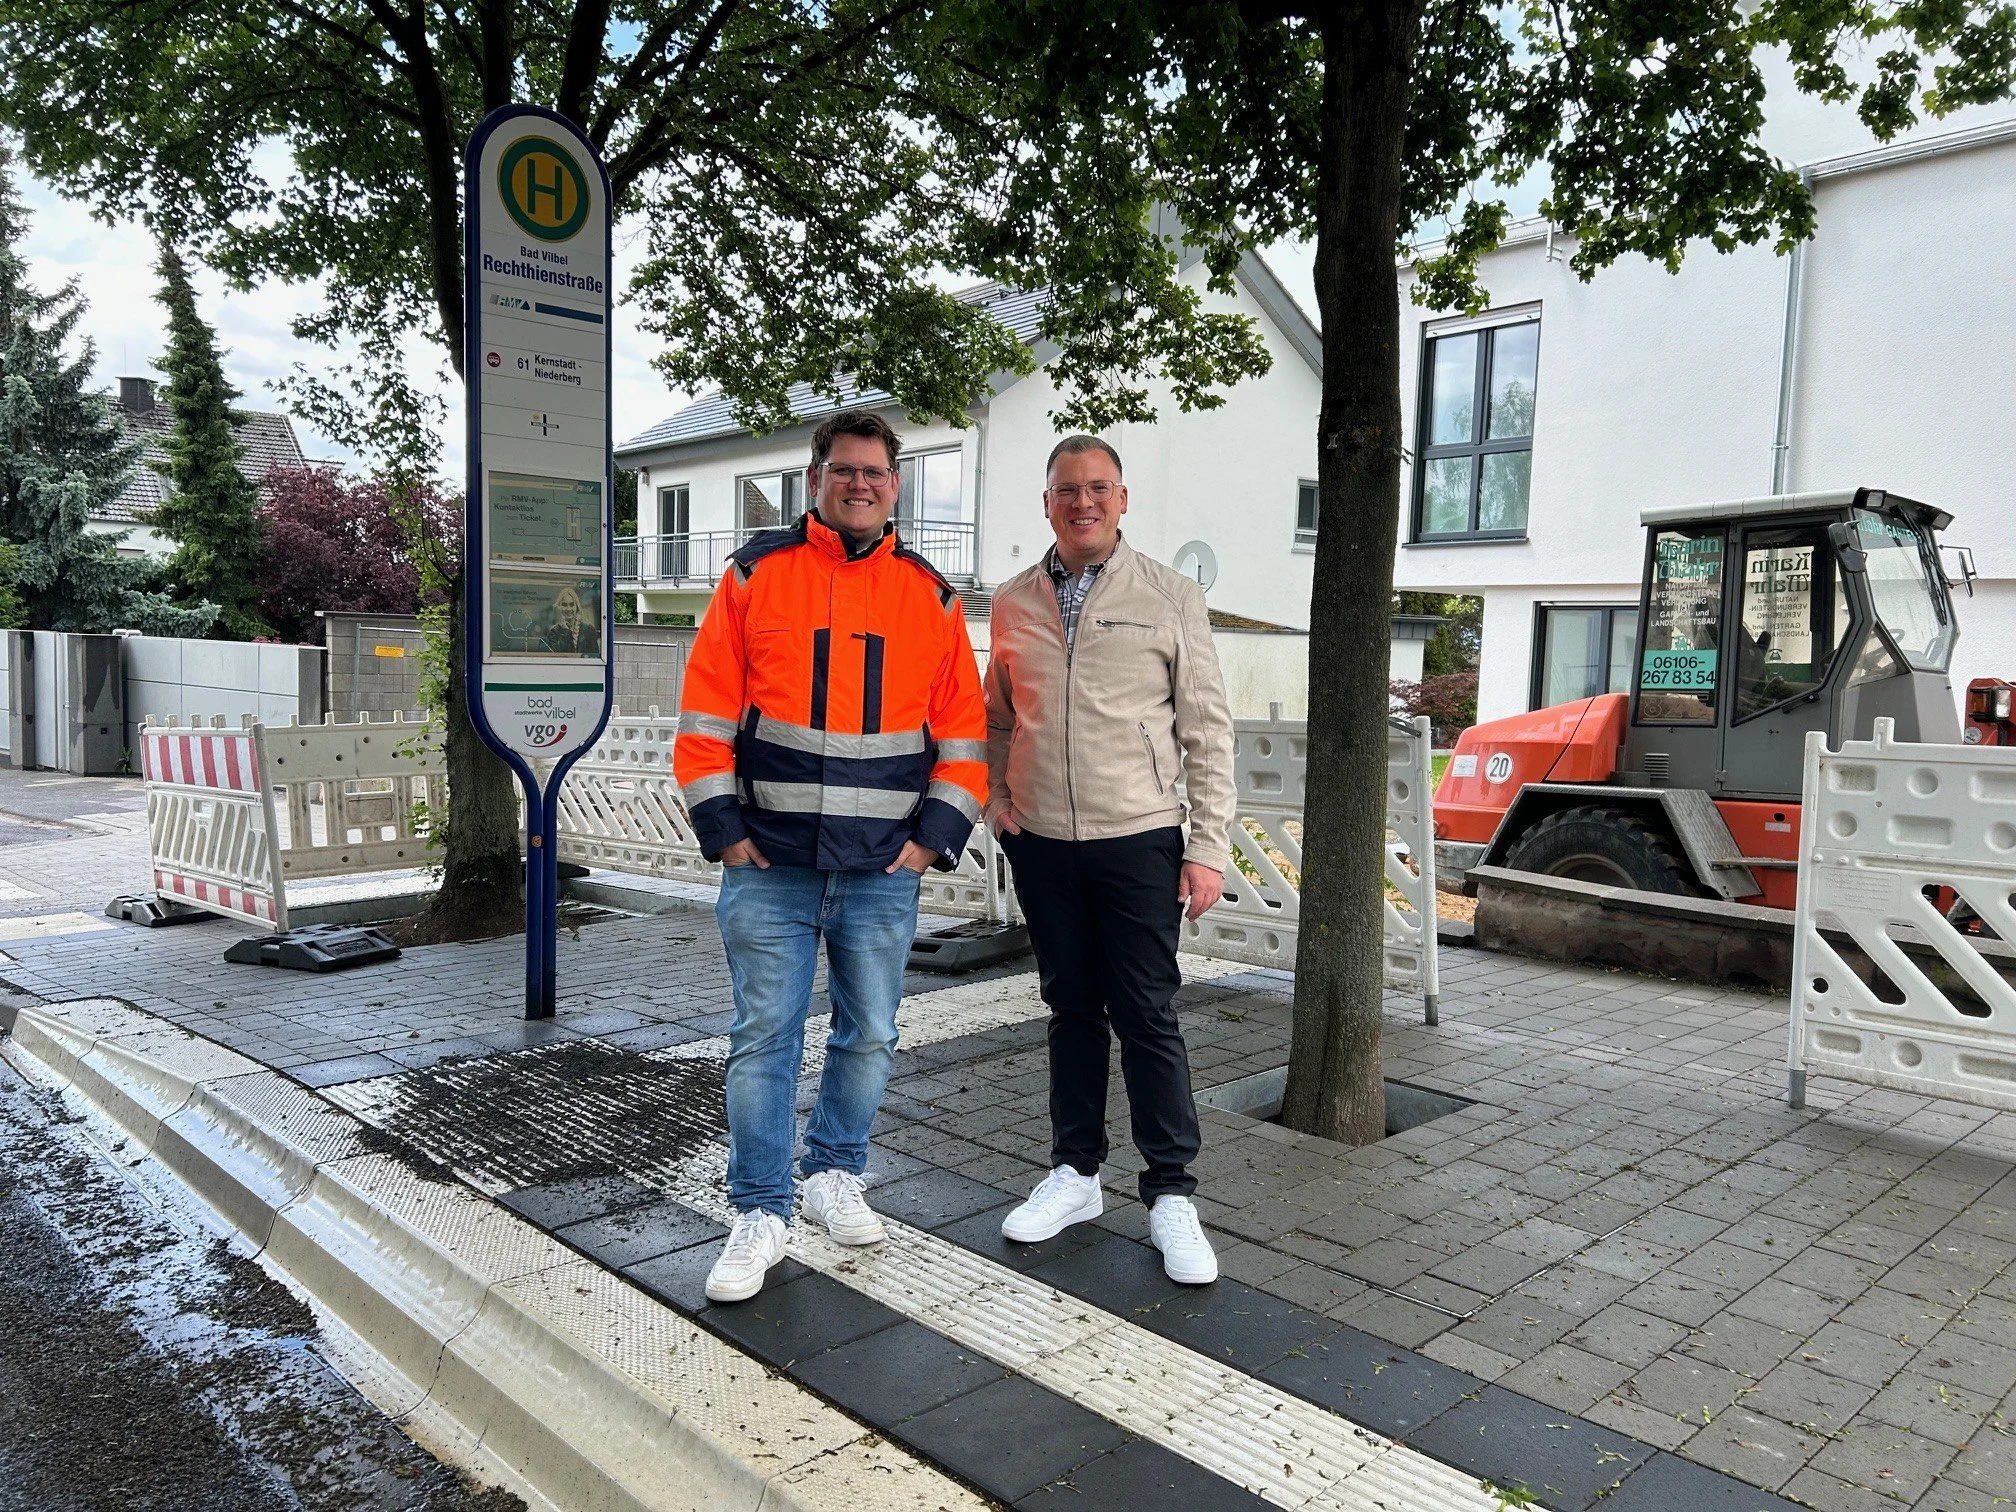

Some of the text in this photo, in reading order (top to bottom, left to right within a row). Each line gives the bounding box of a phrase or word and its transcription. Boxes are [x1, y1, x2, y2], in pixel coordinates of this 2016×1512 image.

[527, 158, 562, 220] H
[520, 246, 568, 266] Bad Vilbel
[483, 254, 603, 294] Rechthienstraße
[517, 357, 529, 370] 61
[534, 354, 576, 370] Kernstadt
[534, 368, 581, 385] Niederberg
[494, 503, 534, 512] Kontaktlos
[1661, 598, 1707, 606] VERUNG
[1650, 618, 1716, 626] LANDSCHAFTSBAU
[1653, 656, 1706, 668] 06106-
[1642, 670, 1716, 684] 267 83 54
[528, 696, 552, 708] bad
[544, 706, 576, 719] vilbel
[524, 724, 556, 744] vgo
[1489, 756, 1510, 778] 20
